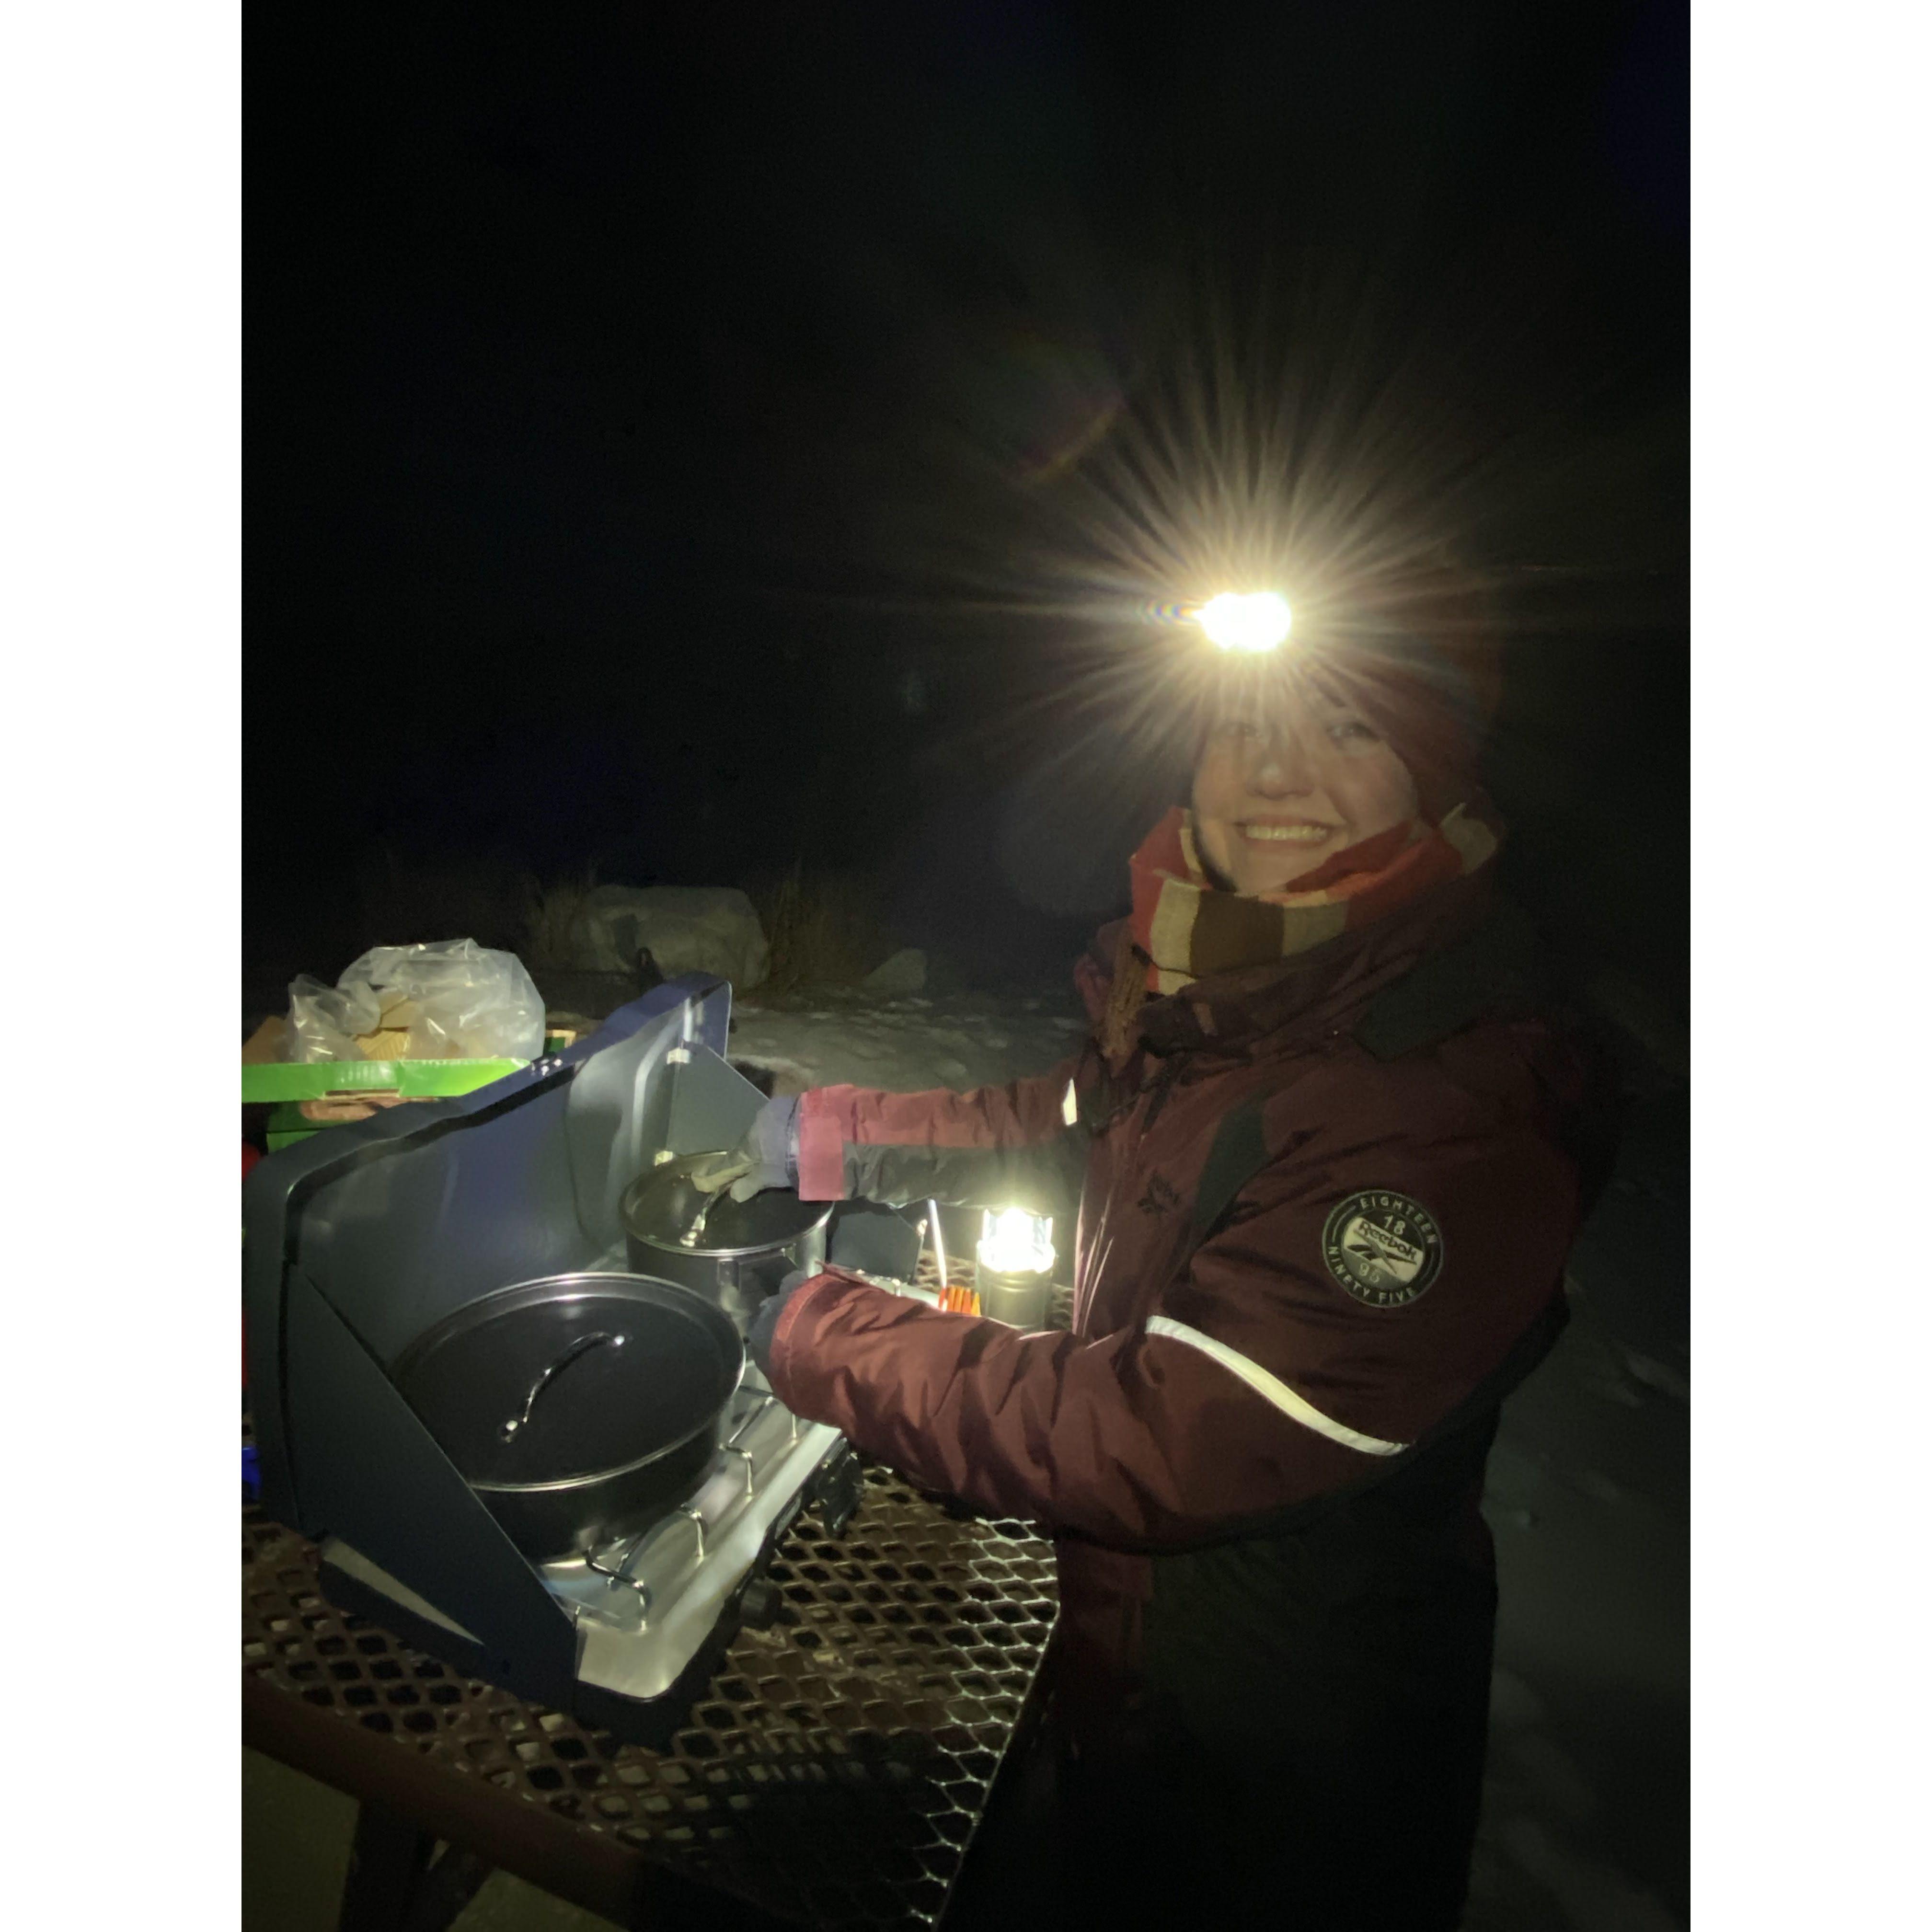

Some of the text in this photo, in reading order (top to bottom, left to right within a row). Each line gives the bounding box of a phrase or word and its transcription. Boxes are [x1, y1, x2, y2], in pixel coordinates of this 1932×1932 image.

[1358, 1220, 1417, 1261] Reebok
[1359, 1196, 1438, 1244] EIGHTEEN
[1384, 1215, 1406, 1235] 18
[1328, 1246, 1370, 1297] NINETY
